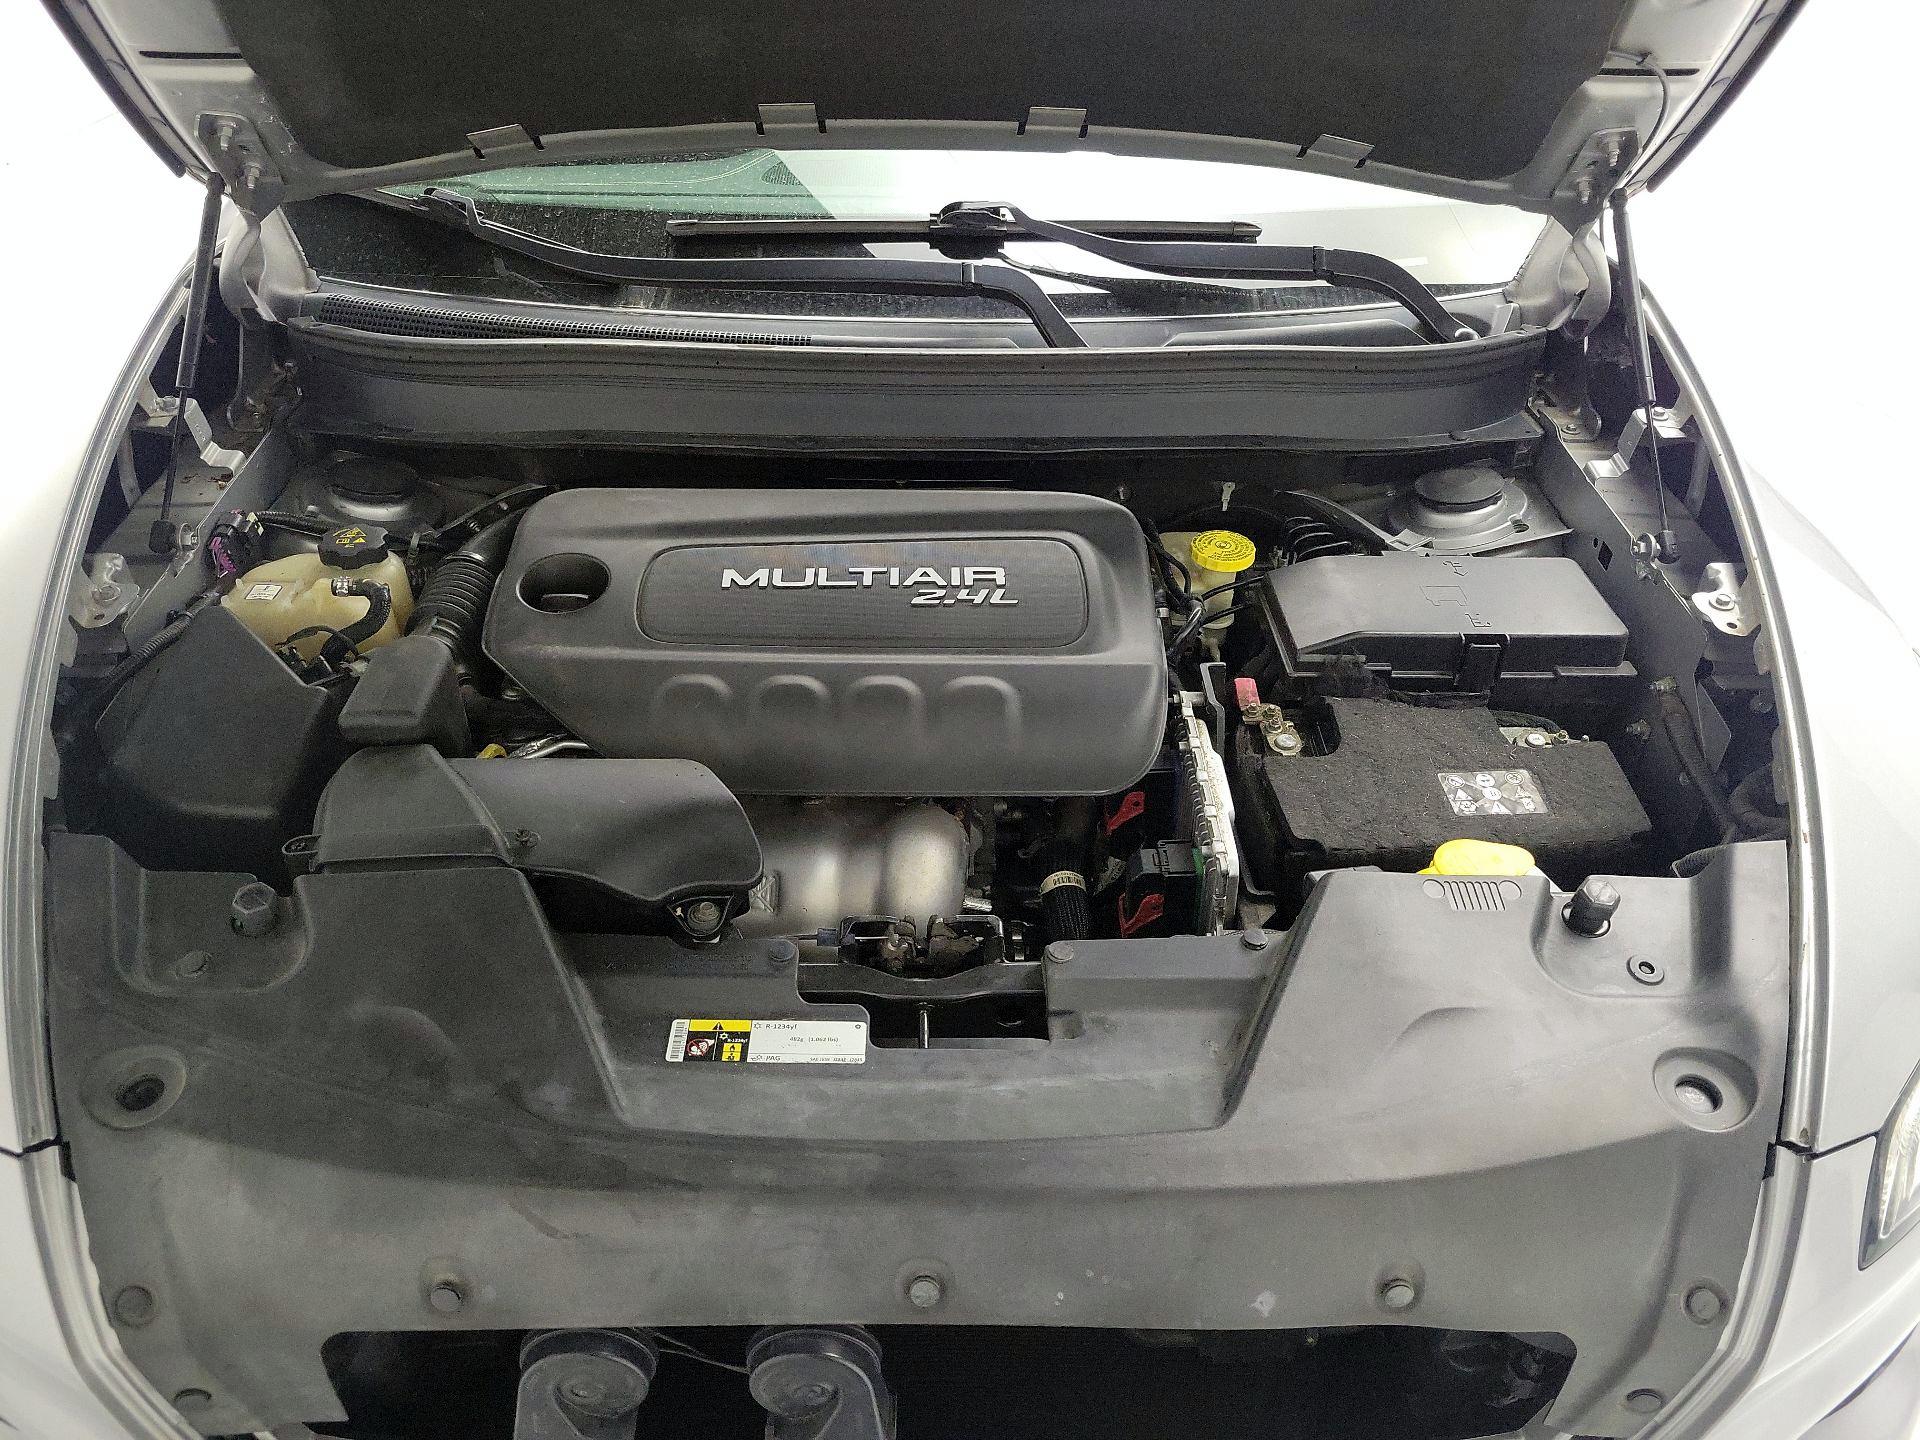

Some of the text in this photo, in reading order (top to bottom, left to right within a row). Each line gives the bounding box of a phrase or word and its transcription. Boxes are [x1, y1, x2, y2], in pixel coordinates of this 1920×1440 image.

[721, 567, 1008, 589] MULTIAIR
[910, 588, 1019, 606] 2.4L
[765, 1023, 797, 1031] R-1234yf
